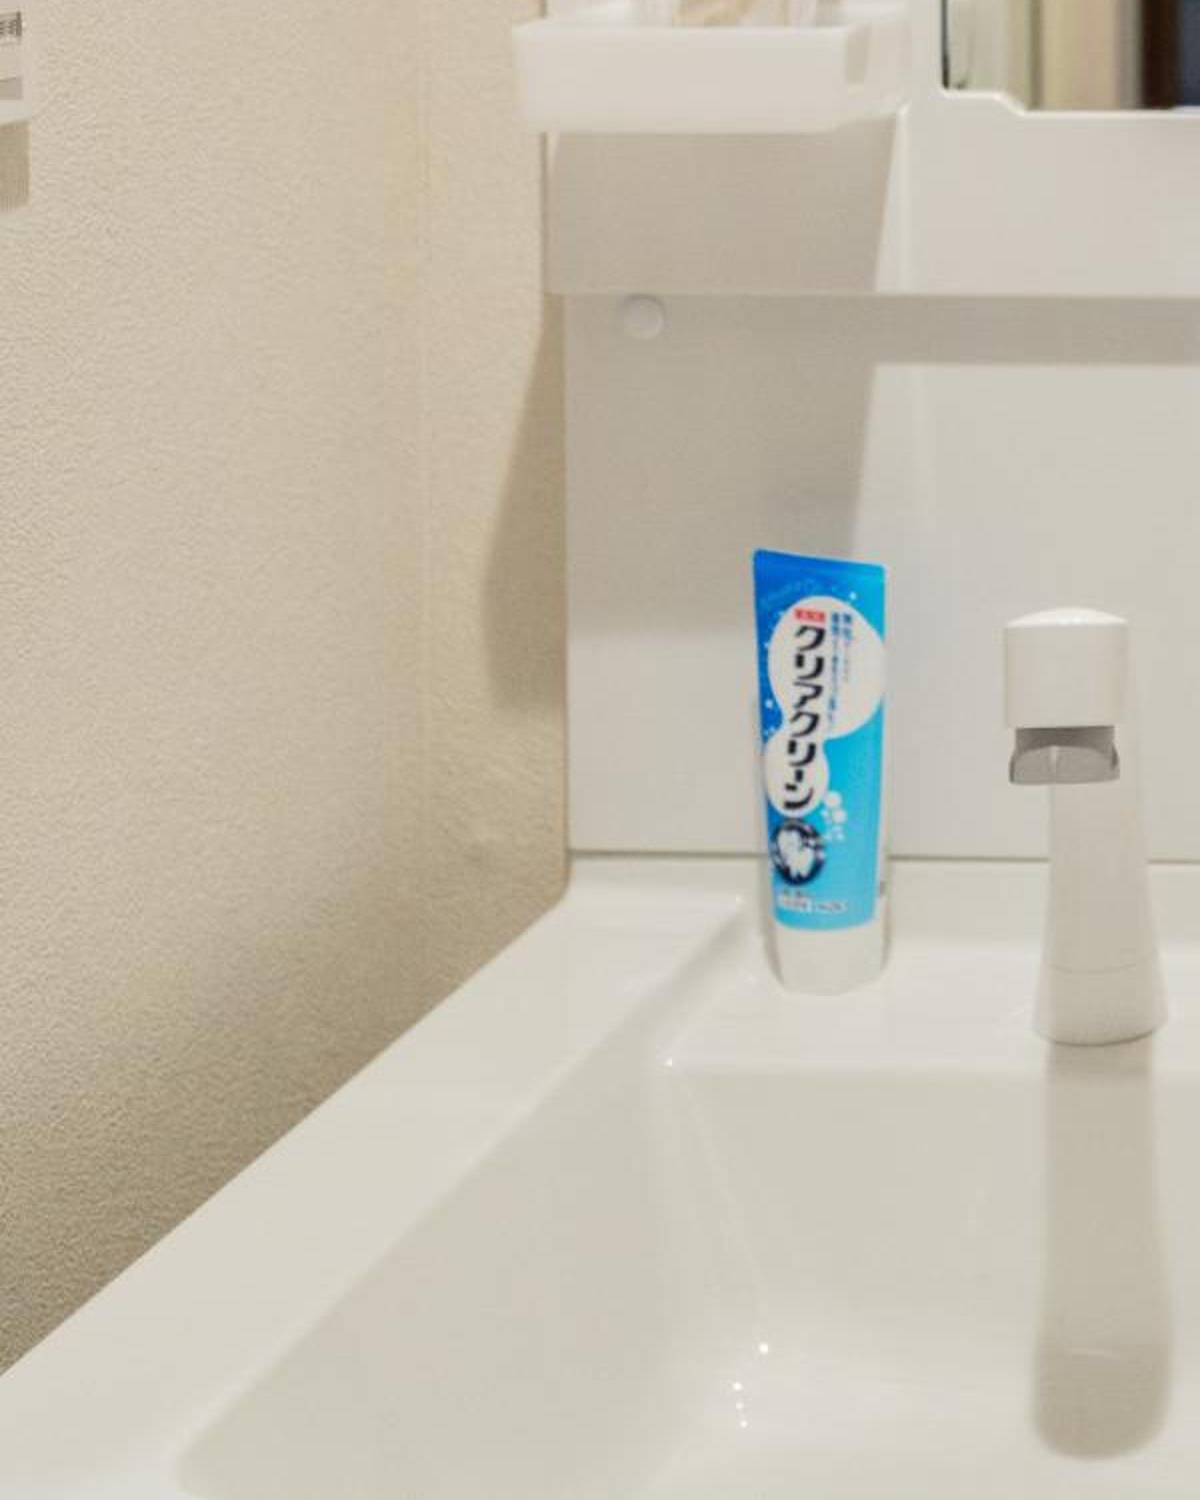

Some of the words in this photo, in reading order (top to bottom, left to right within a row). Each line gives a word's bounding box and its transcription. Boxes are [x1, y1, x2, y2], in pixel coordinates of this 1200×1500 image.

[783, 624, 826, 810] クリアクリーン
